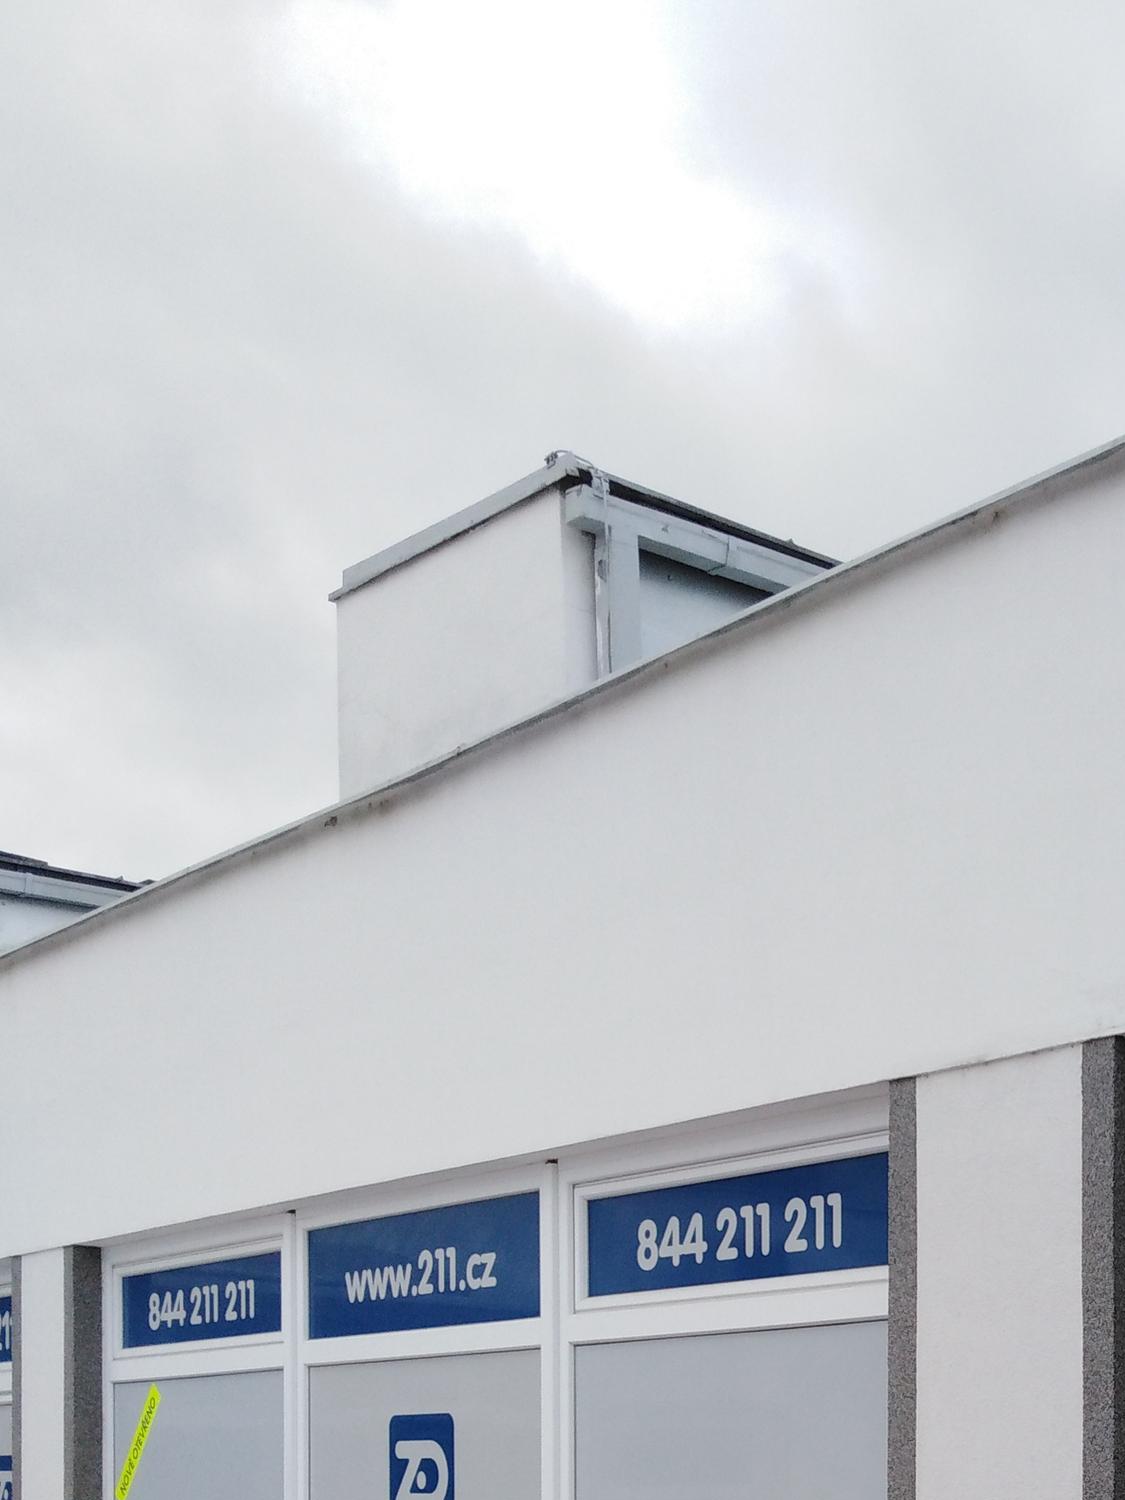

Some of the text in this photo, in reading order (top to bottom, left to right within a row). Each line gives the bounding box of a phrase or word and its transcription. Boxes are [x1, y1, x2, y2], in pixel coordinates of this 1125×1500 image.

[637, 1193, 842, 1271] 844 211 211
[149, 1279, 254, 1331] 844 211 211
[345, 1247, 497, 1303] www.211.cz
[119, 1397, 156, 1496] NOVĚ OTEVŘENO
